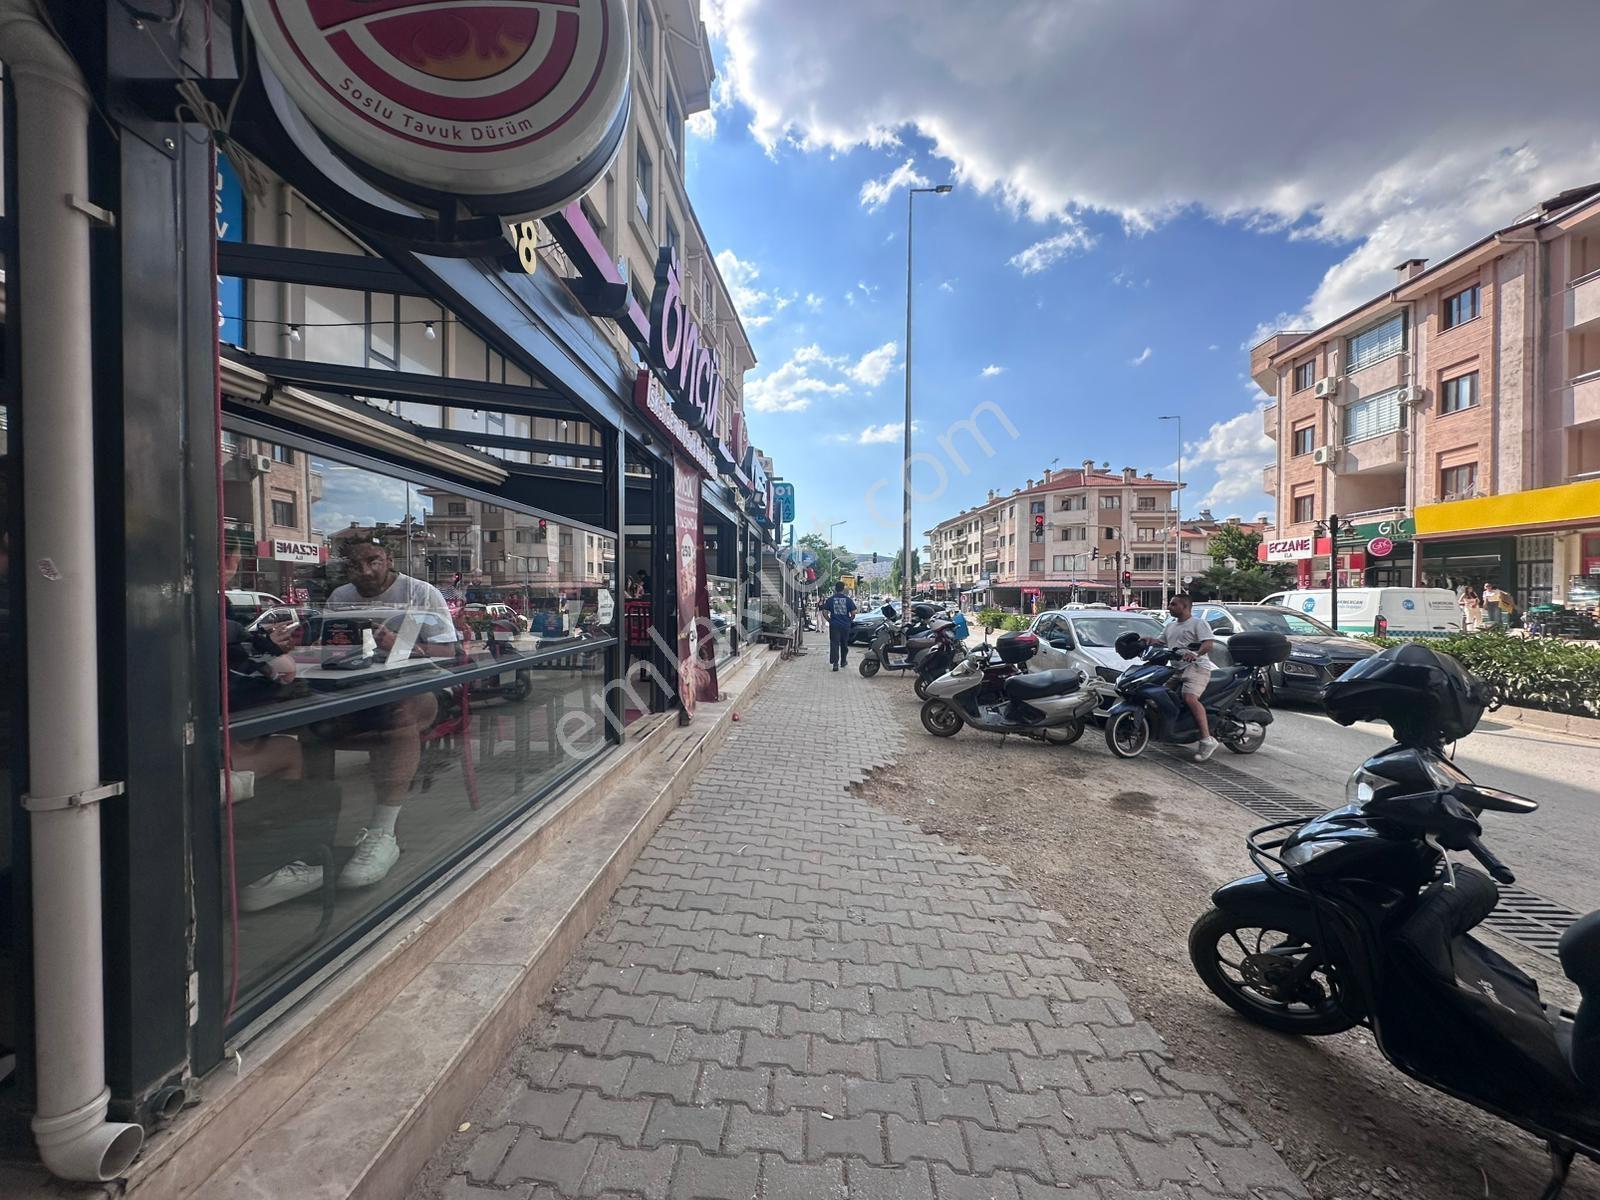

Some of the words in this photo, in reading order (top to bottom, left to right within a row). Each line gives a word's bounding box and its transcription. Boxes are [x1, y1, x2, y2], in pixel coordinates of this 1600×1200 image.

[339, 78, 393, 120] Soslu
[403, 114, 463, 141] Tavuk
[471, 118, 533, 141] Dürüm
[1269, 538, 1311, 554] ECZANE
